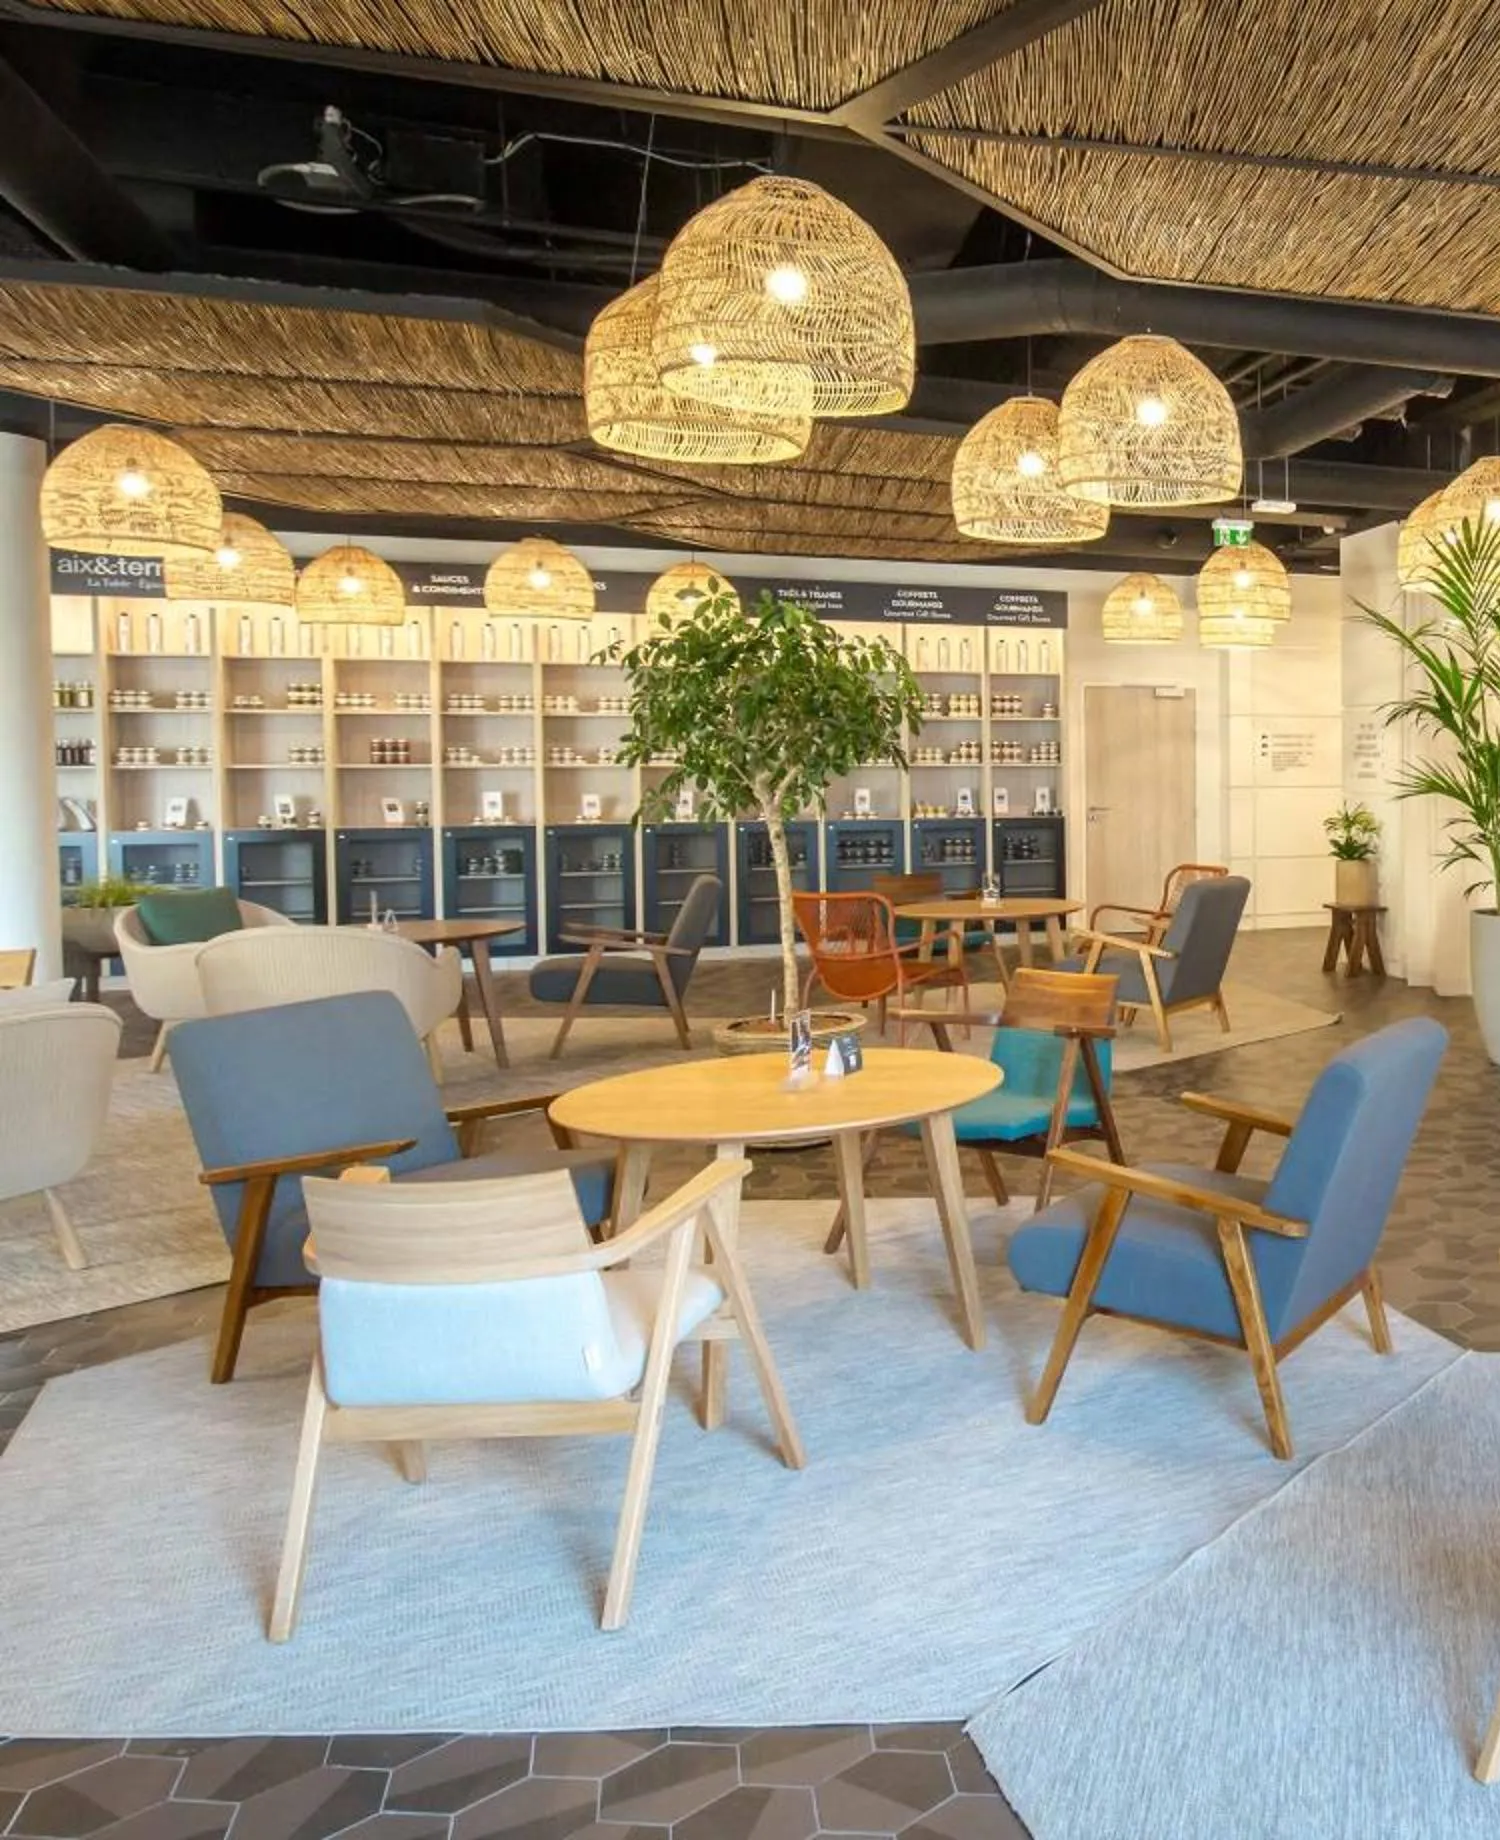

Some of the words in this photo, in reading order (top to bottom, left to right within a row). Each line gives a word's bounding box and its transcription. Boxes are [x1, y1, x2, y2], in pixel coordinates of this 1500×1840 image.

[57, 554, 164, 577] aix&terr
[430, 574, 470, 585] SAUCES
[421, 585, 485, 596] CONDIMENT
